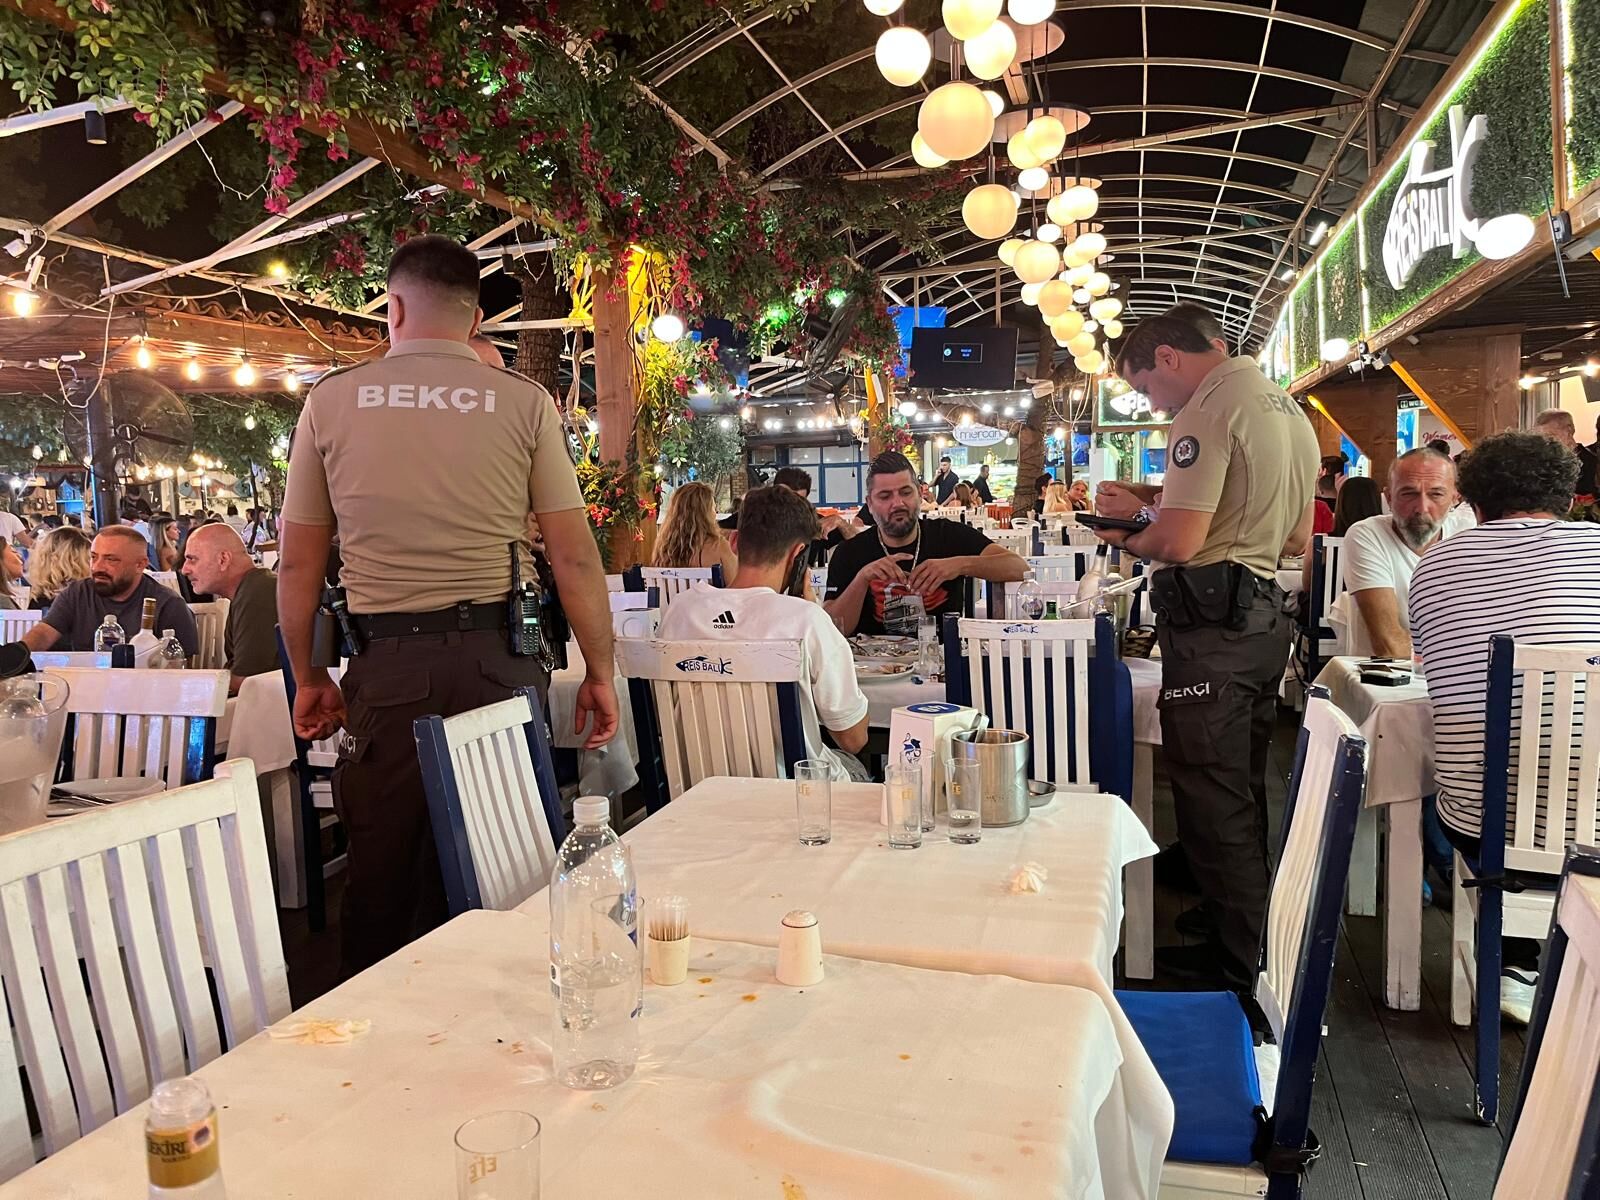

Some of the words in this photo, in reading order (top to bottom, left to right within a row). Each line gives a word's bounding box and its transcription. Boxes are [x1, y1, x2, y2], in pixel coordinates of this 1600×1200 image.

[960, 429, 1001, 439] mercan
[684, 660, 701, 671] REIS
[702, 656, 733, 675] BALIK
